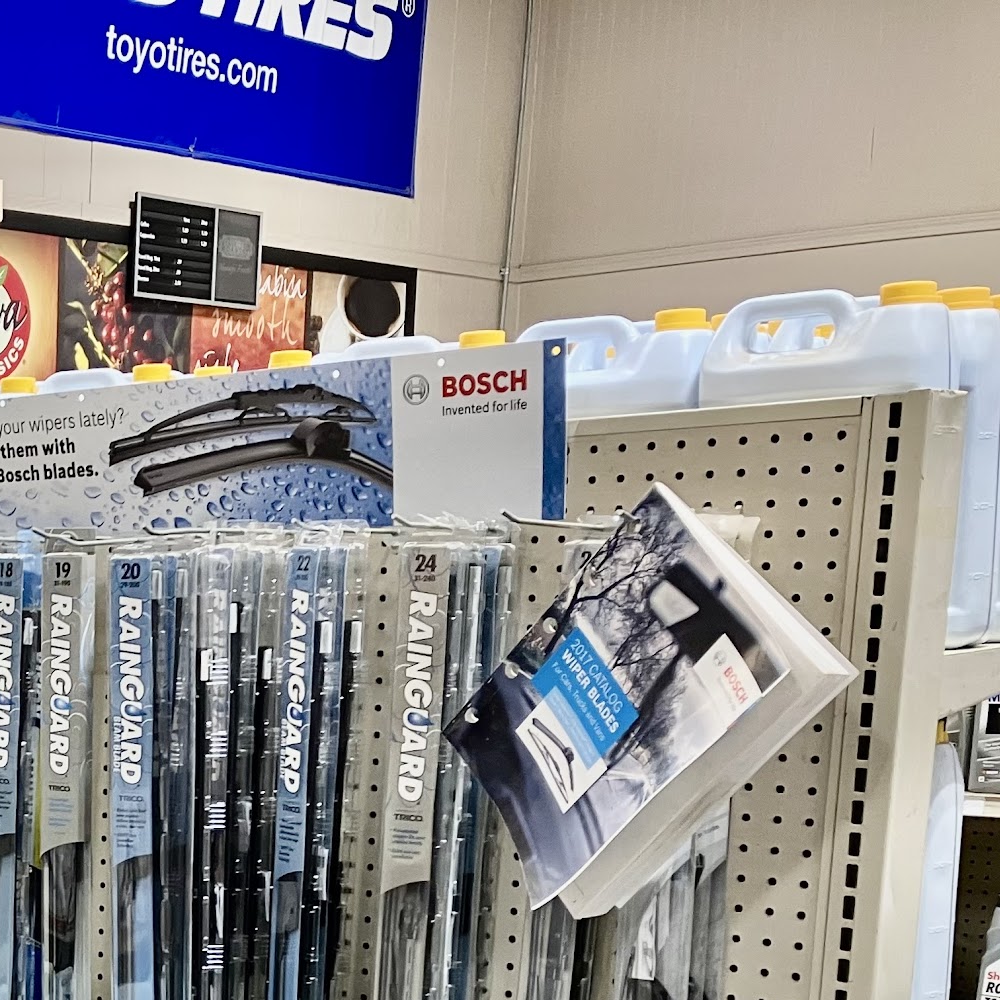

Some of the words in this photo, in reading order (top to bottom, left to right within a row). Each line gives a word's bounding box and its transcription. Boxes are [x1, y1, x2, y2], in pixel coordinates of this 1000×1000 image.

[105, 24, 278, 93] toyotires.com
[259, 266, 307, 300] abica
[441, 368, 527, 398] BOSCH
[27, 413, 76, 434] wipers
[79, 407, 125, 431] lately?
[441, 402, 486, 417] Invented
[488, 401, 505, 413] for
[508, 399, 528, 411] life
[0, 441, 38, 459] them
[41, 438, 76, 456] with
[43, 461, 99, 481] blades.
[0, 562, 13, 578] 18
[55, 562, 71, 579] 19
[121, 562, 140, 580] 20
[297, 555, 311, 571] 22
[414, 553, 437, 573] 24
[49, 593, 73, 776] RAINGUARD
[118, 595, 145, 785] RAINGUARD
[561, 648, 592, 692] WIPER
[586, 686, 620, 734] BLADES
[570, 638, 588, 662] 2017
[587, 662, 623, 714] CATALOG
[723, 666, 749, 704] BOSCH
[284, 588, 311, 795] RAINGUARD
[397, 589, 439, 803] RAINGUARD
